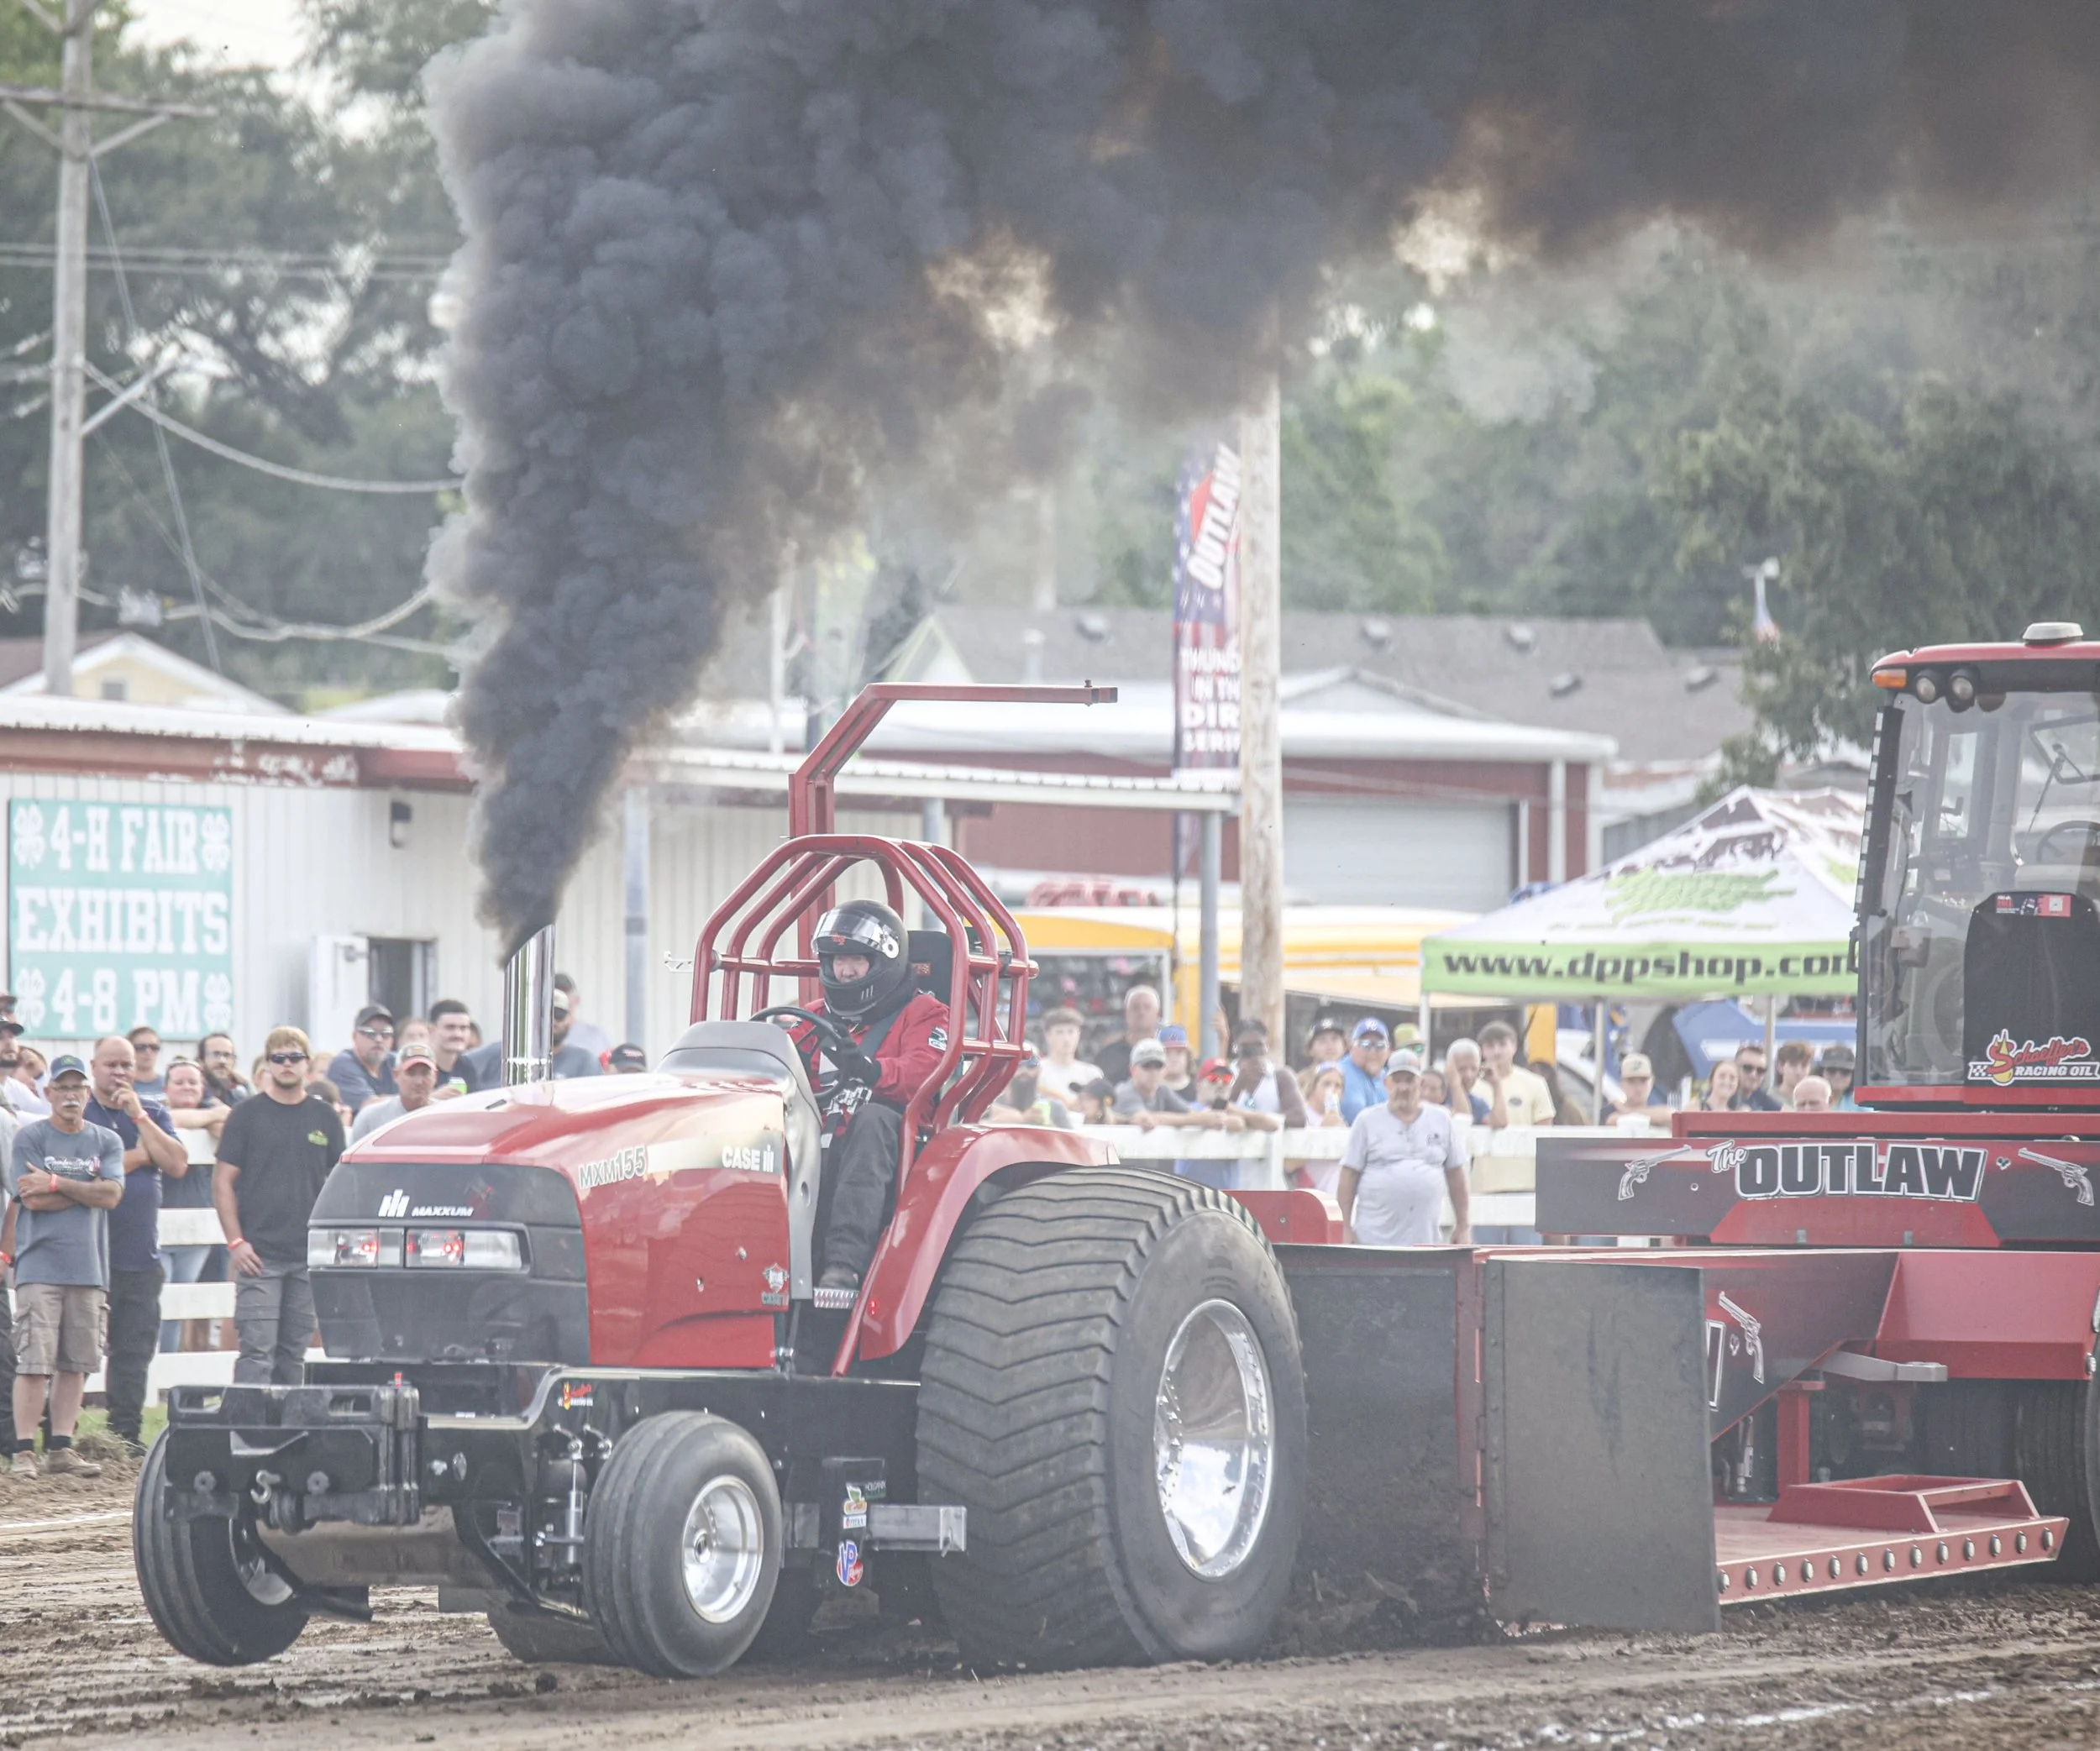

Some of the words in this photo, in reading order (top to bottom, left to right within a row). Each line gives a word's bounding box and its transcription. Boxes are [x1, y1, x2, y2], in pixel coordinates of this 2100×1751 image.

[1179, 647, 1241, 673] THUND
[1216, 676, 1241, 701] TH
[1180, 702, 1241, 730] DIR
[1181, 729, 1241, 752] SERI
[50, 804, 111, 872] 4-H
[119, 806, 199, 874] FAIR
[15, 886, 229, 955] EXHIBITS
[50, 967, 118, 1033] 4-8
[132, 968, 202, 1034] PM
[1986, 1037, 2091, 1075] Schaeffer's
[2015, 1065, 2067, 1077] RACING
[2069, 1065, 2093, 1077] OIL
[578, 1145, 647, 1190] MXM155
[722, 1145, 760, 1172] CASE
[1706, 1140, 1749, 1173] The
[1735, 1143, 1987, 1201] OUTLAW
[411, 1205, 475, 1217] MAXXUM
